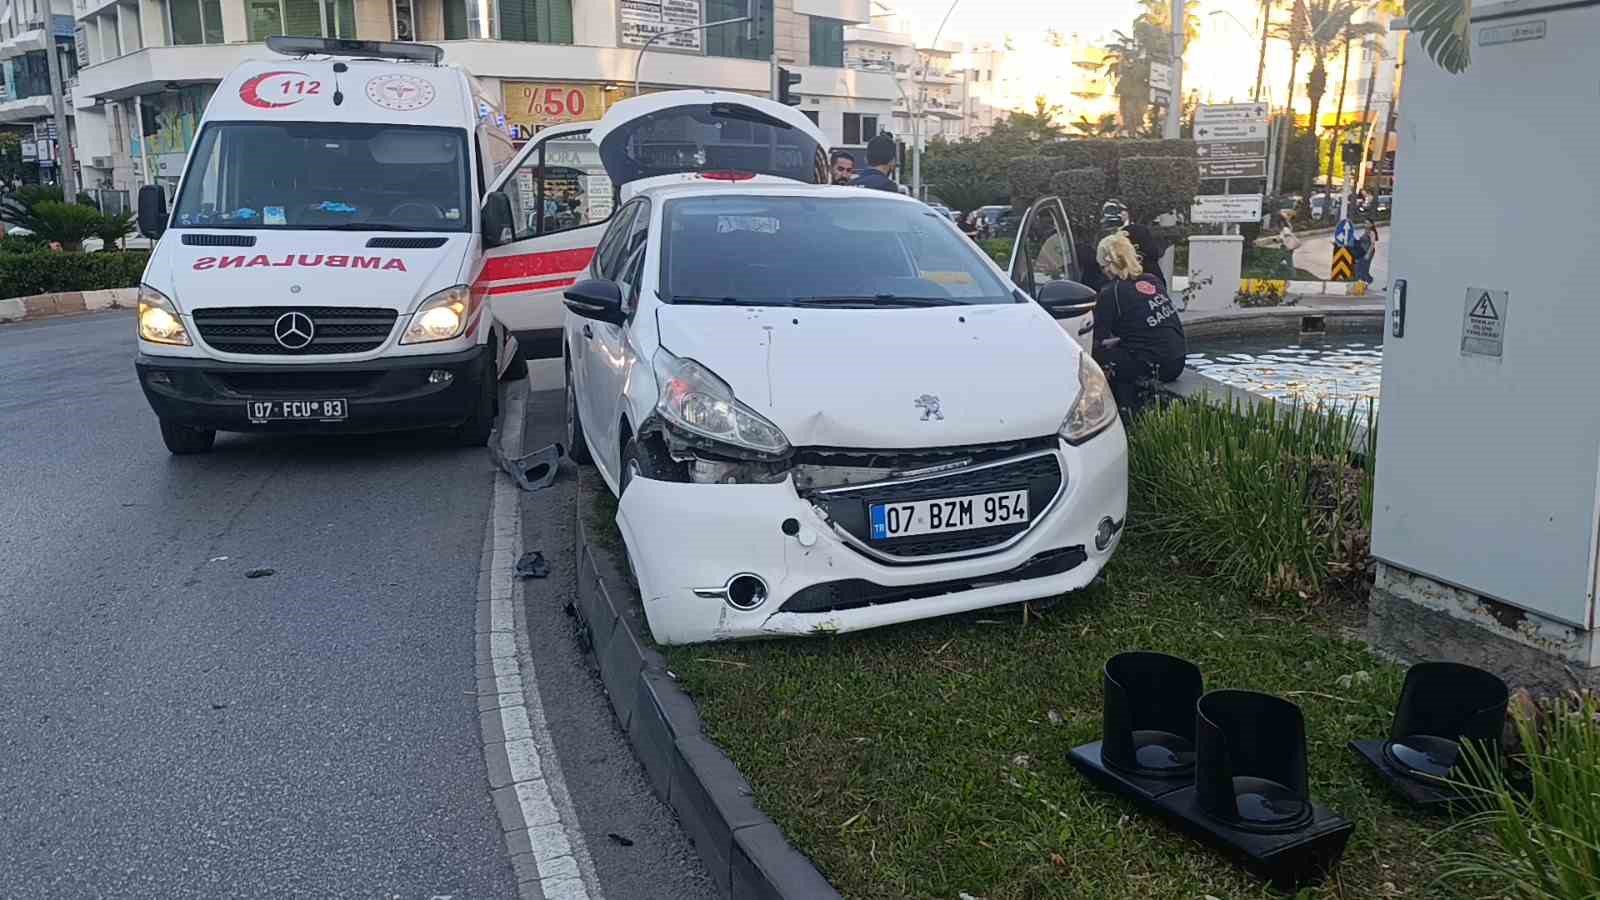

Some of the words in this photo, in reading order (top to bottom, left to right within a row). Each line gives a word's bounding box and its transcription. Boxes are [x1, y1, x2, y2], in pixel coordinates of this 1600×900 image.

[280, 80, 321, 95] 112
[523, 87, 585, 116] %50
[254, 402, 273, 418] 07
[283, 401, 311, 417] FCU
[323, 400, 342, 417] 83
[887, 506, 915, 534] 07
[929, 499, 974, 530] BZM
[984, 493, 1025, 523] 954
